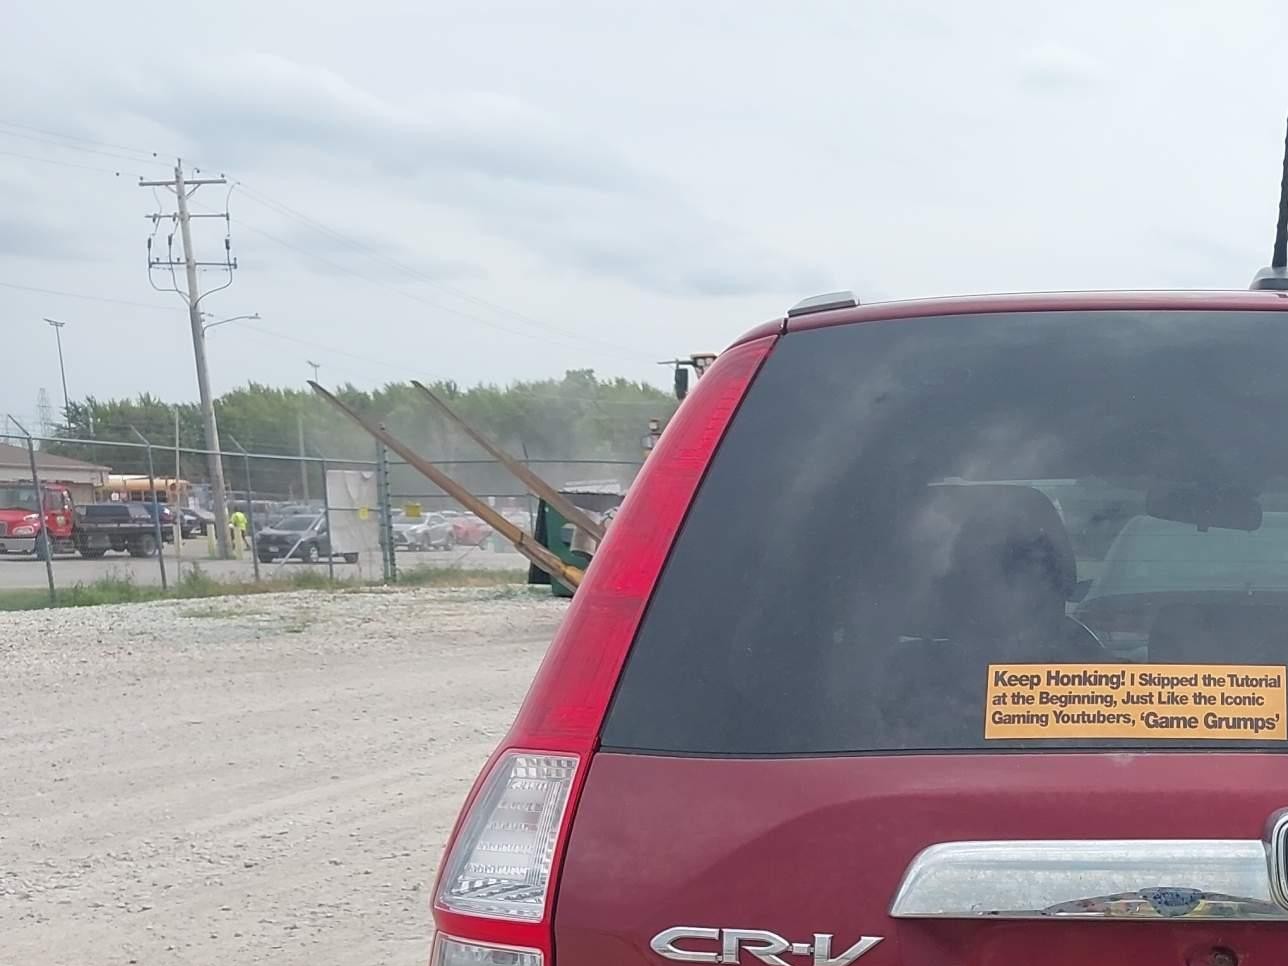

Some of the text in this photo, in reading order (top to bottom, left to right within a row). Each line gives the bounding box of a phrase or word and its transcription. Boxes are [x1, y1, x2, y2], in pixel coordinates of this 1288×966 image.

[994, 670, 1281, 690] Keep Honking! I Skipped the Tutorial
[992, 691, 1265, 708] at the Beginning, Just Like the Iconic
[991, 710, 1049, 727] Gaming
[1053, 709, 1136, 727] Youtubers,
